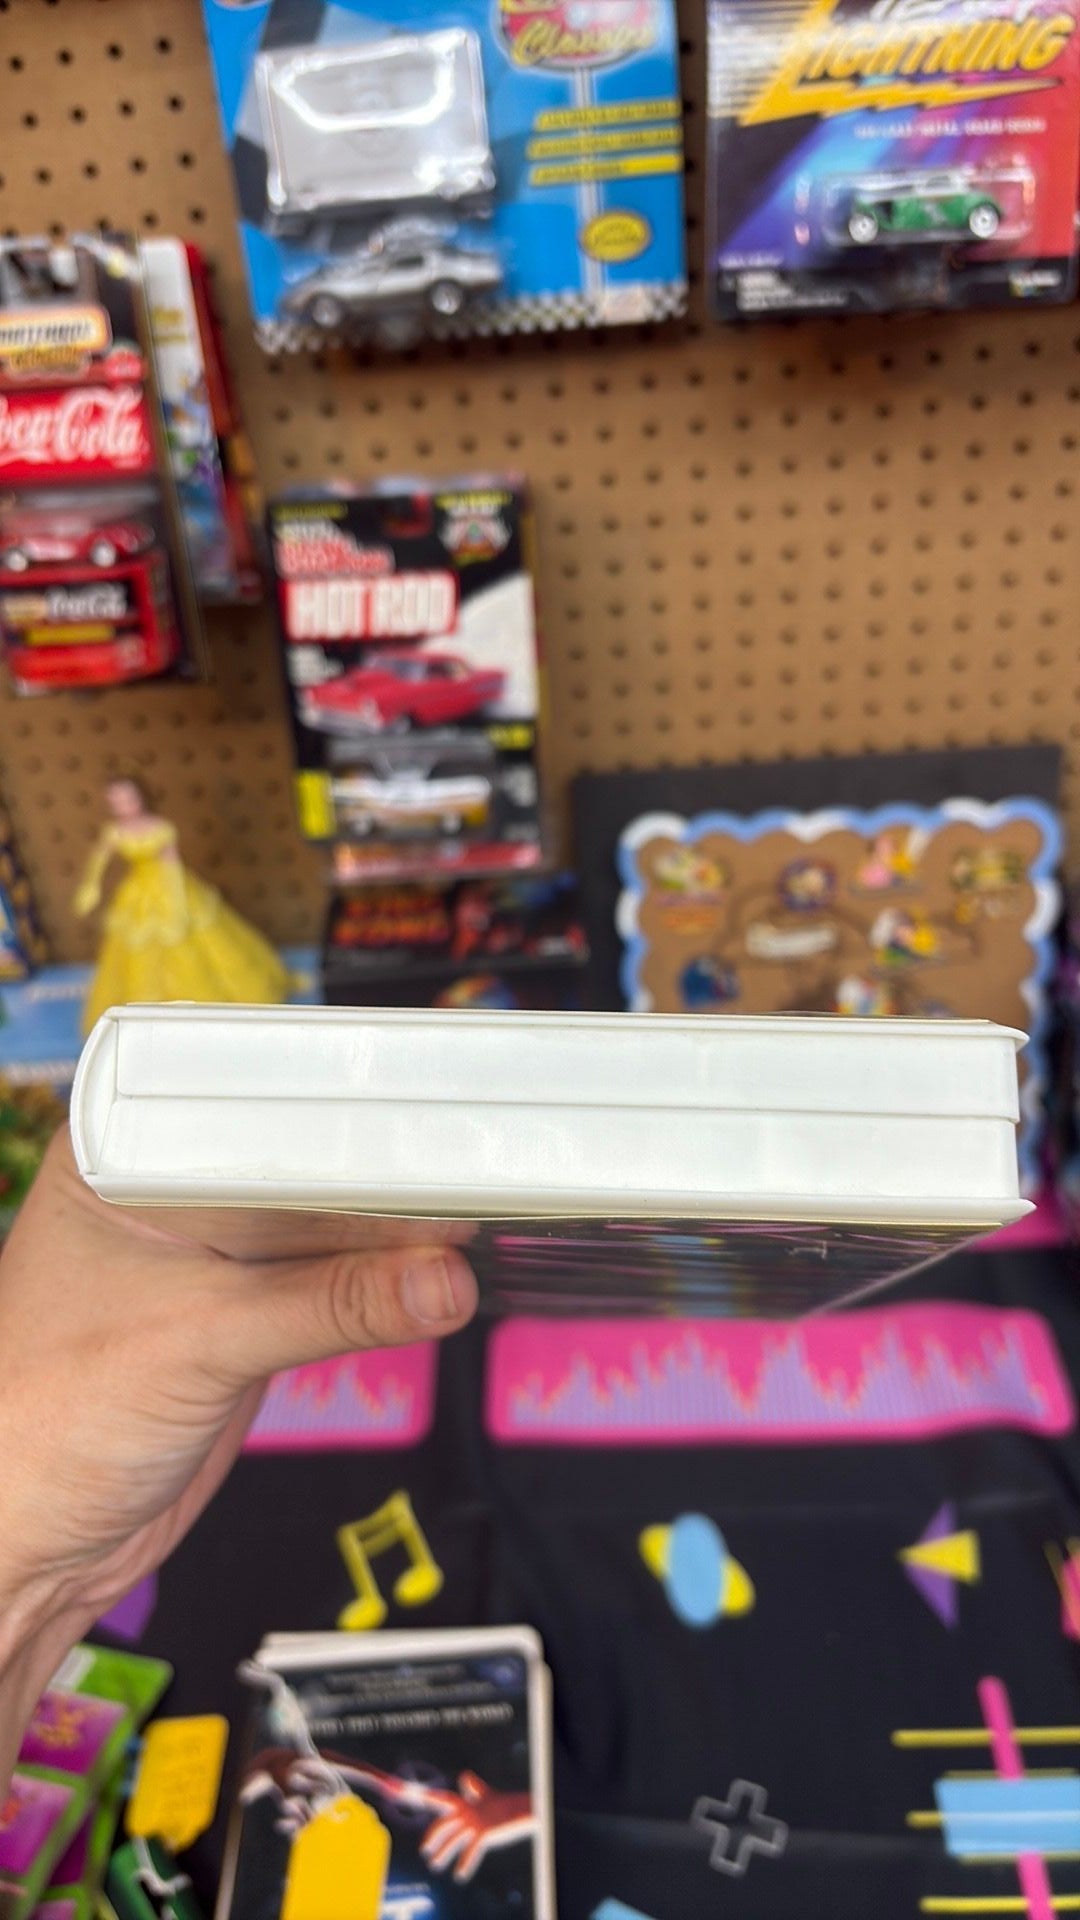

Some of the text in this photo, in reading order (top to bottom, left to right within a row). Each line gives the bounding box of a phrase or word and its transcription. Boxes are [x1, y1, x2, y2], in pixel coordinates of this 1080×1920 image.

[738, 0, 1076, 126] LIGHTNING
[290, 572, 455, 639] HOT ROD
